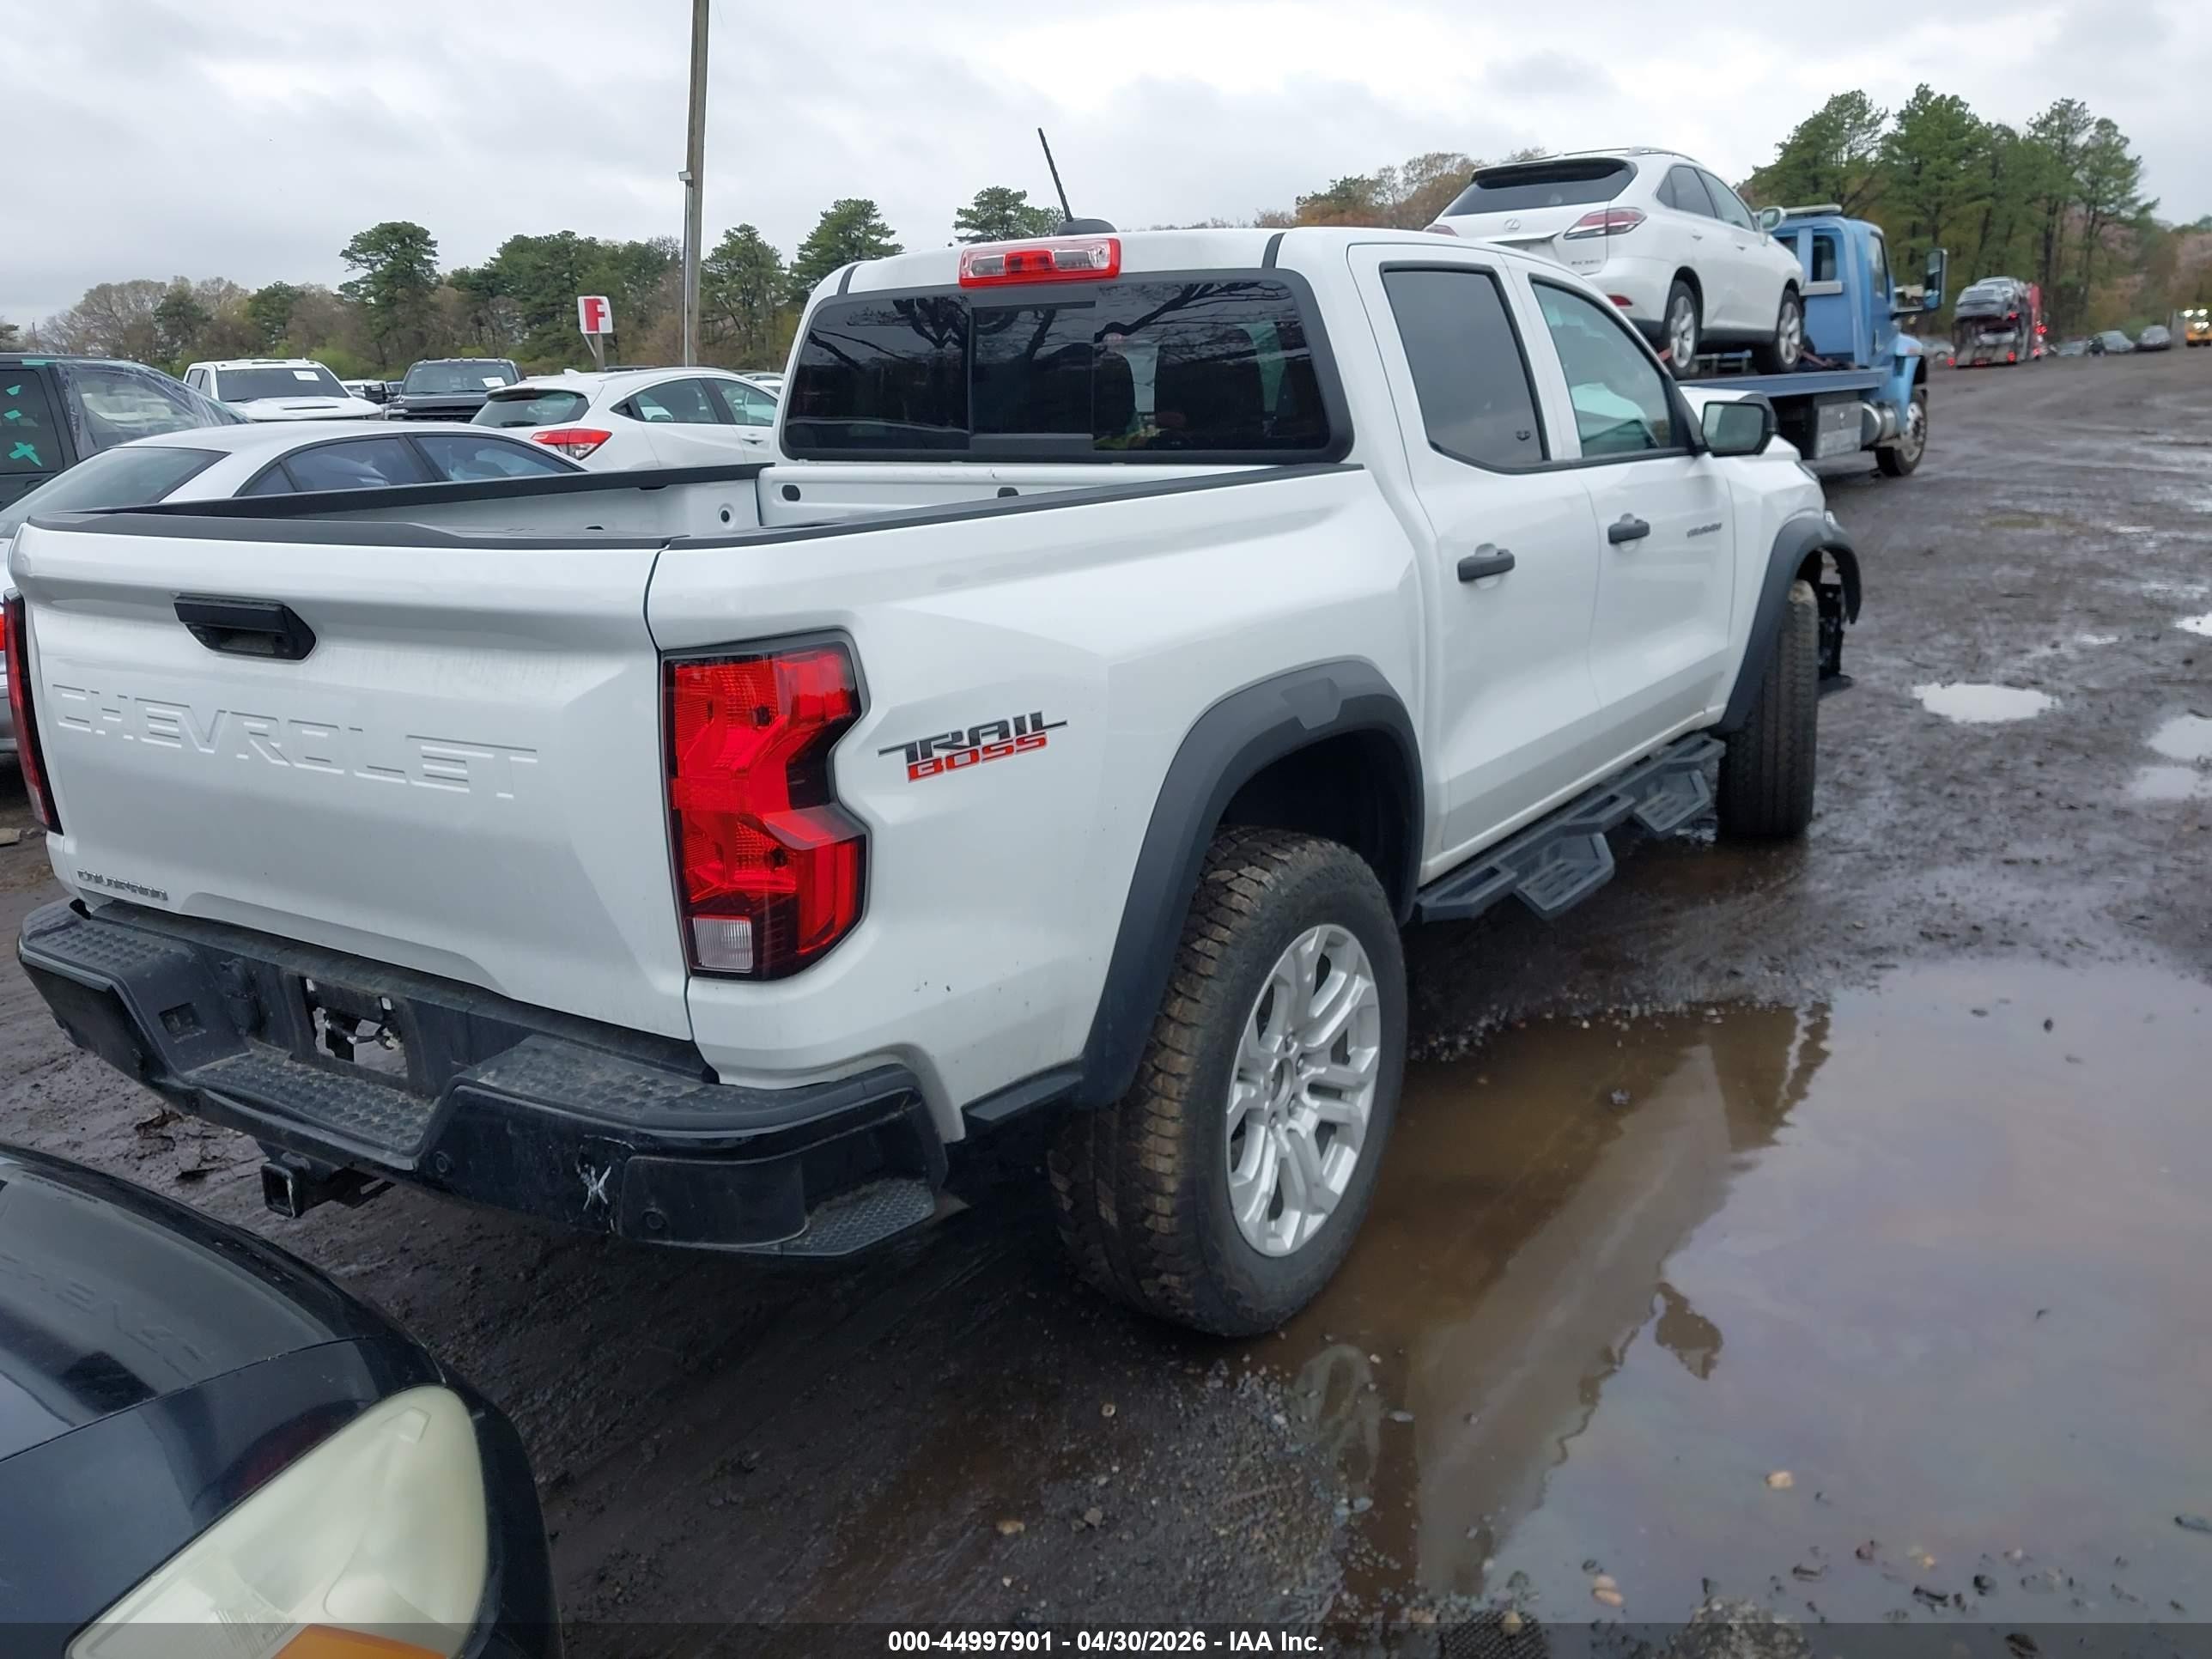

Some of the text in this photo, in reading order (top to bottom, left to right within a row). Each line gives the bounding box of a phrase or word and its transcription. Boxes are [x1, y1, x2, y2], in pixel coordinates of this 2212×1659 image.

[584, 298, 605, 331] F
[52, 684, 539, 799] CHEVROLET
[878, 710, 1068, 763] TRAIL
[907, 732, 1048, 783] BOSS
